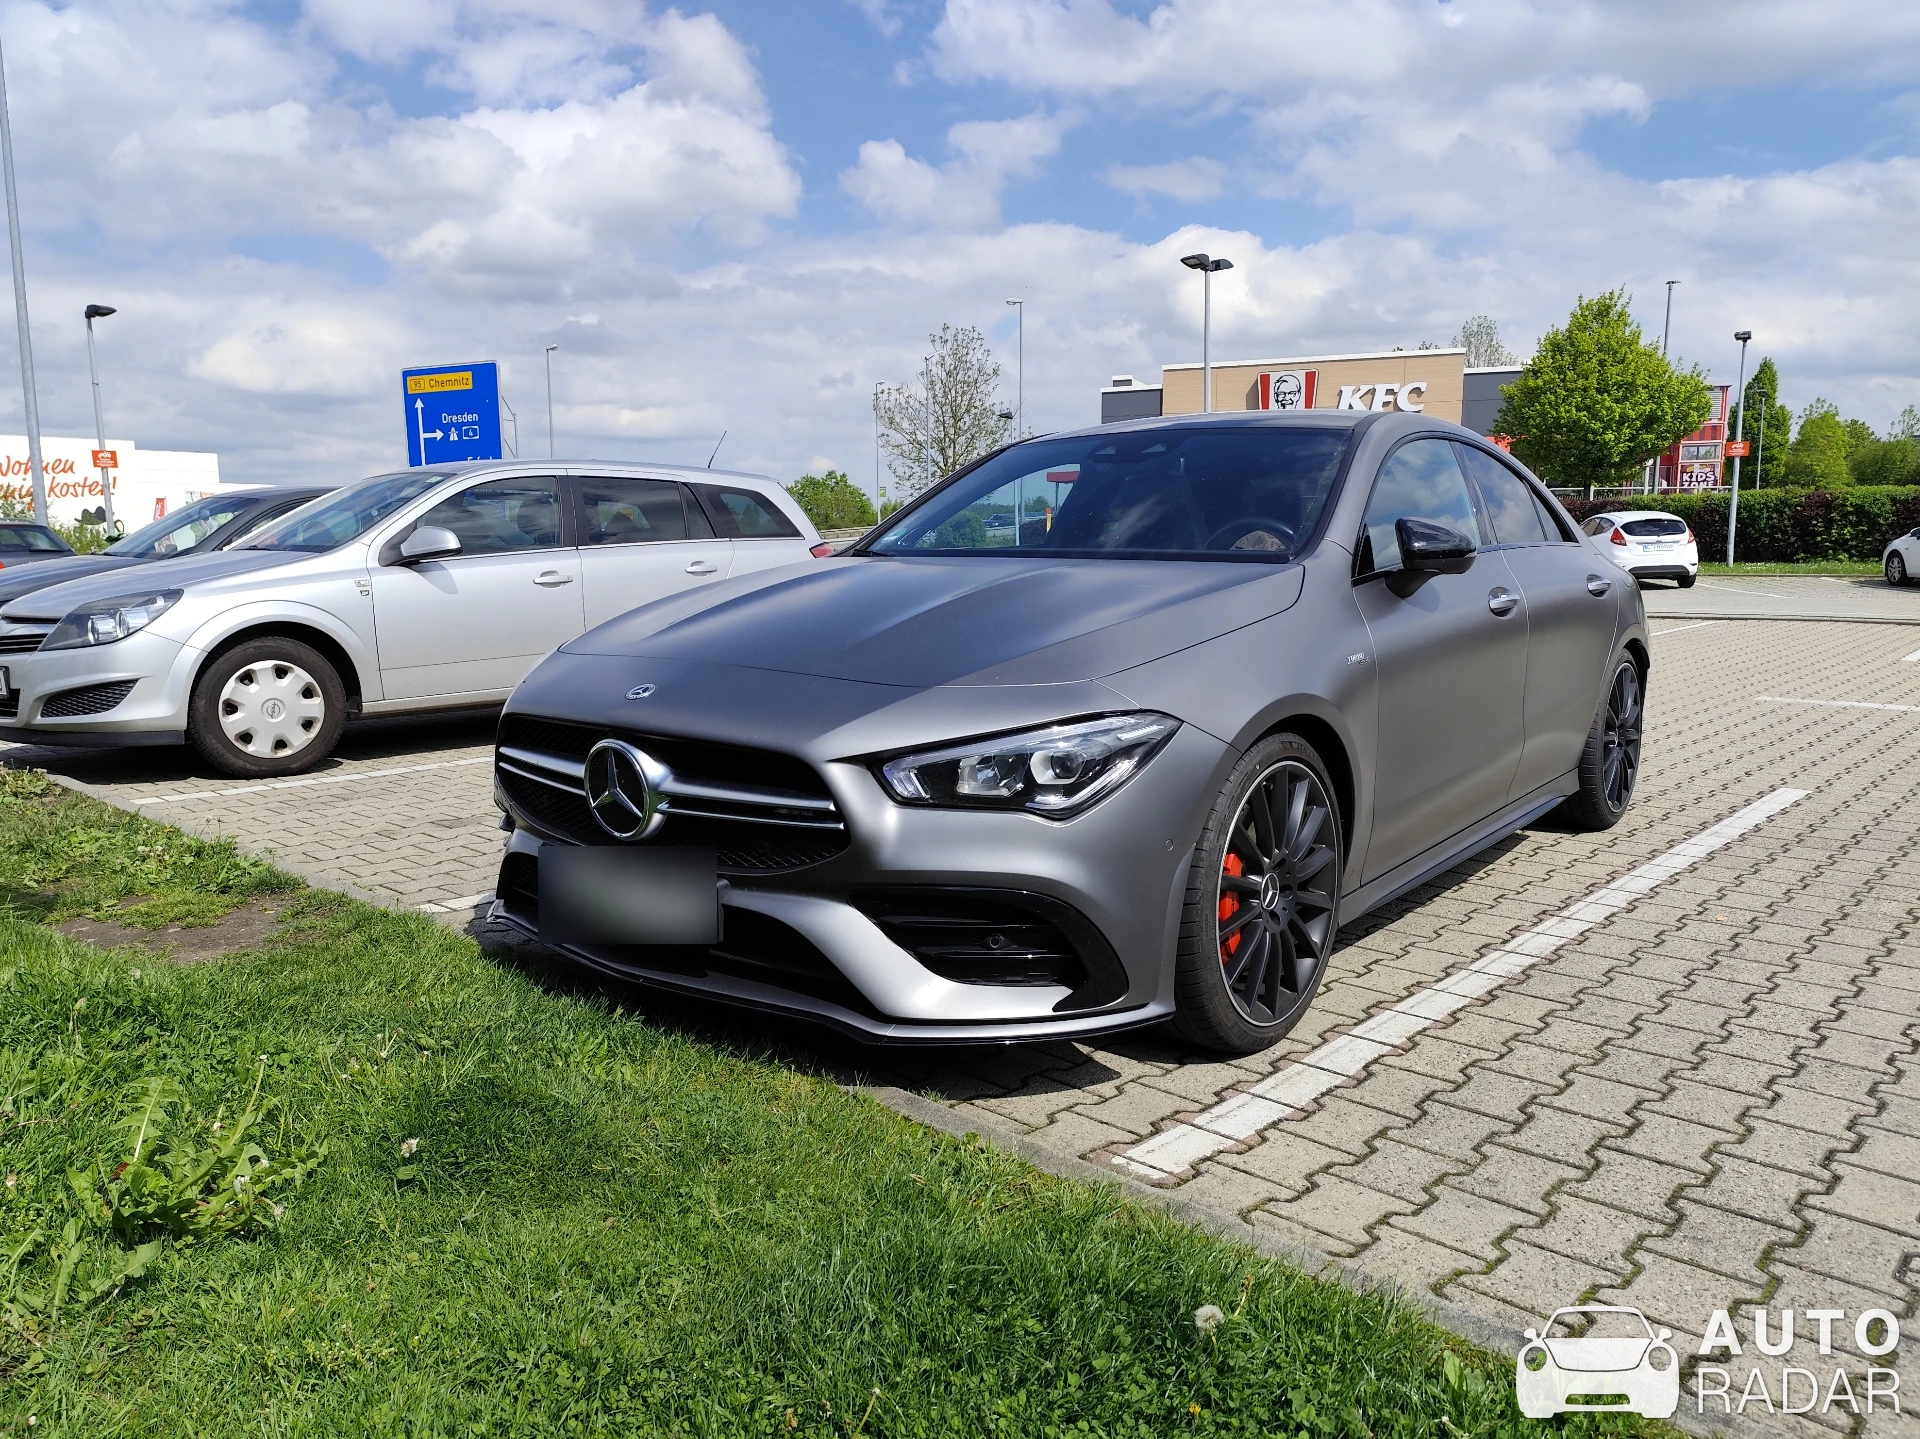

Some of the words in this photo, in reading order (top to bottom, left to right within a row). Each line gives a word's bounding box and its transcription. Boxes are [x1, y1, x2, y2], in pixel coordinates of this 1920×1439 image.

[413, 380, 422, 389] 95
[428, 376, 470, 389] Chemnitz
[1339, 381, 1428, 413] KFC
[441, 411, 479, 424] Dresden
[1682, 471, 1716, 482] KIDS
